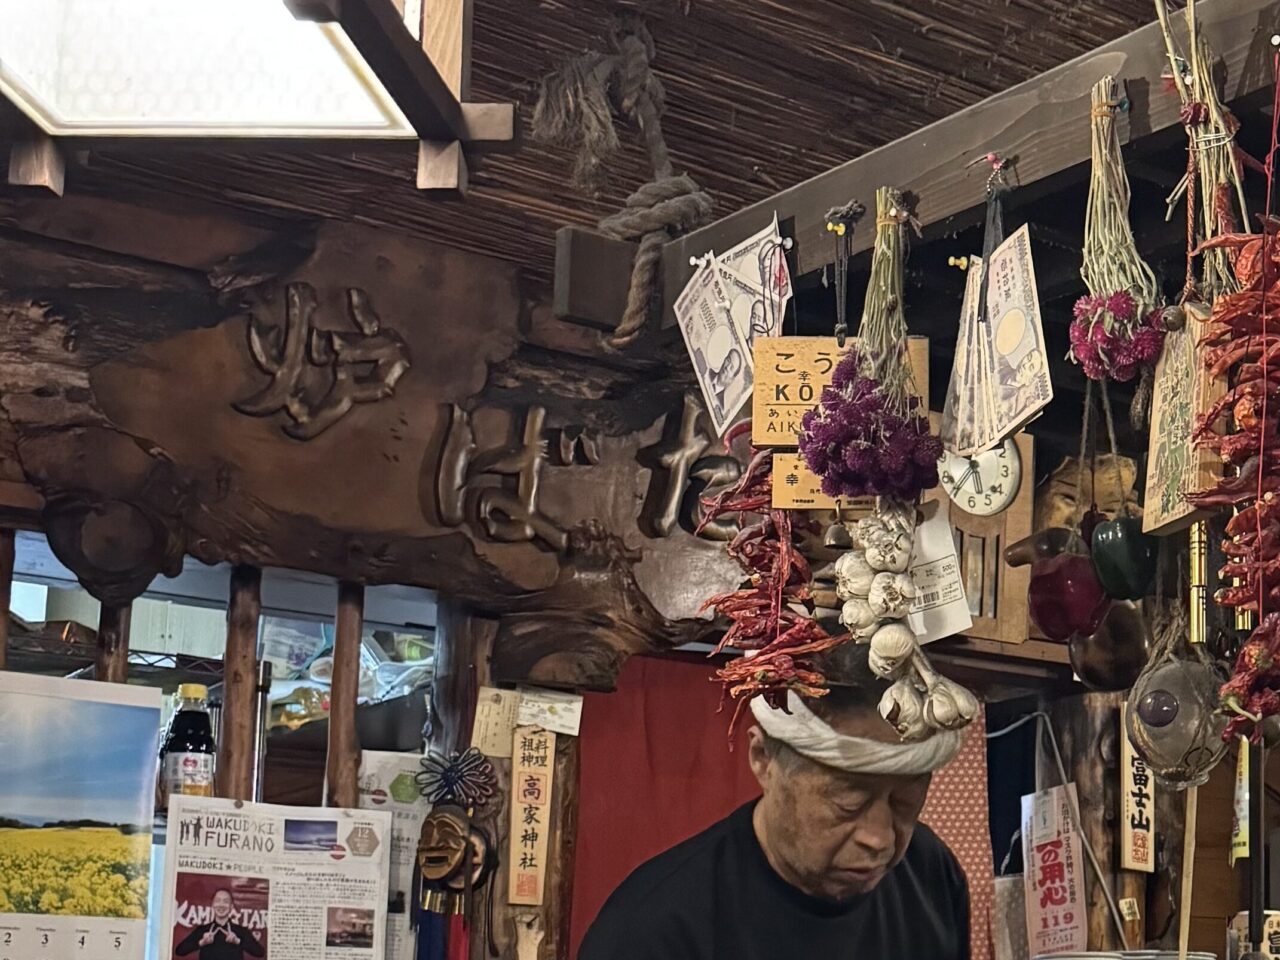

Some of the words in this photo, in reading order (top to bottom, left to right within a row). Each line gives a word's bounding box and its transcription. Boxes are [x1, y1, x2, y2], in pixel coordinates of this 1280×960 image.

[775, 383, 832, 402] KŌ
[767, 421, 803, 433] AIK
[942, 471, 950, 484] 8
[1001, 466, 1009, 478] 3
[996, 484, 1004, 495] 4
[968, 496, 976, 508] 6
[984, 494, 992, 506] 5
[520, 737, 534, 768] 祖神
[535, 739, 549, 767] 料理
[1130, 755, 1151, 833] 富士山
[205, 816, 275, 835] WAKUDOKI
[519, 775, 541, 869] 高家神社
[204, 832, 275, 853] FURANO
[178, 859, 225, 871] WAKUDOKI
[1041, 912, 1074, 930] 119
[4, 932, 12, 944] 2
[41, 934, 49, 945] 3
[78, 935, 86, 946] 4
[114, 937, 121, 948] 5
